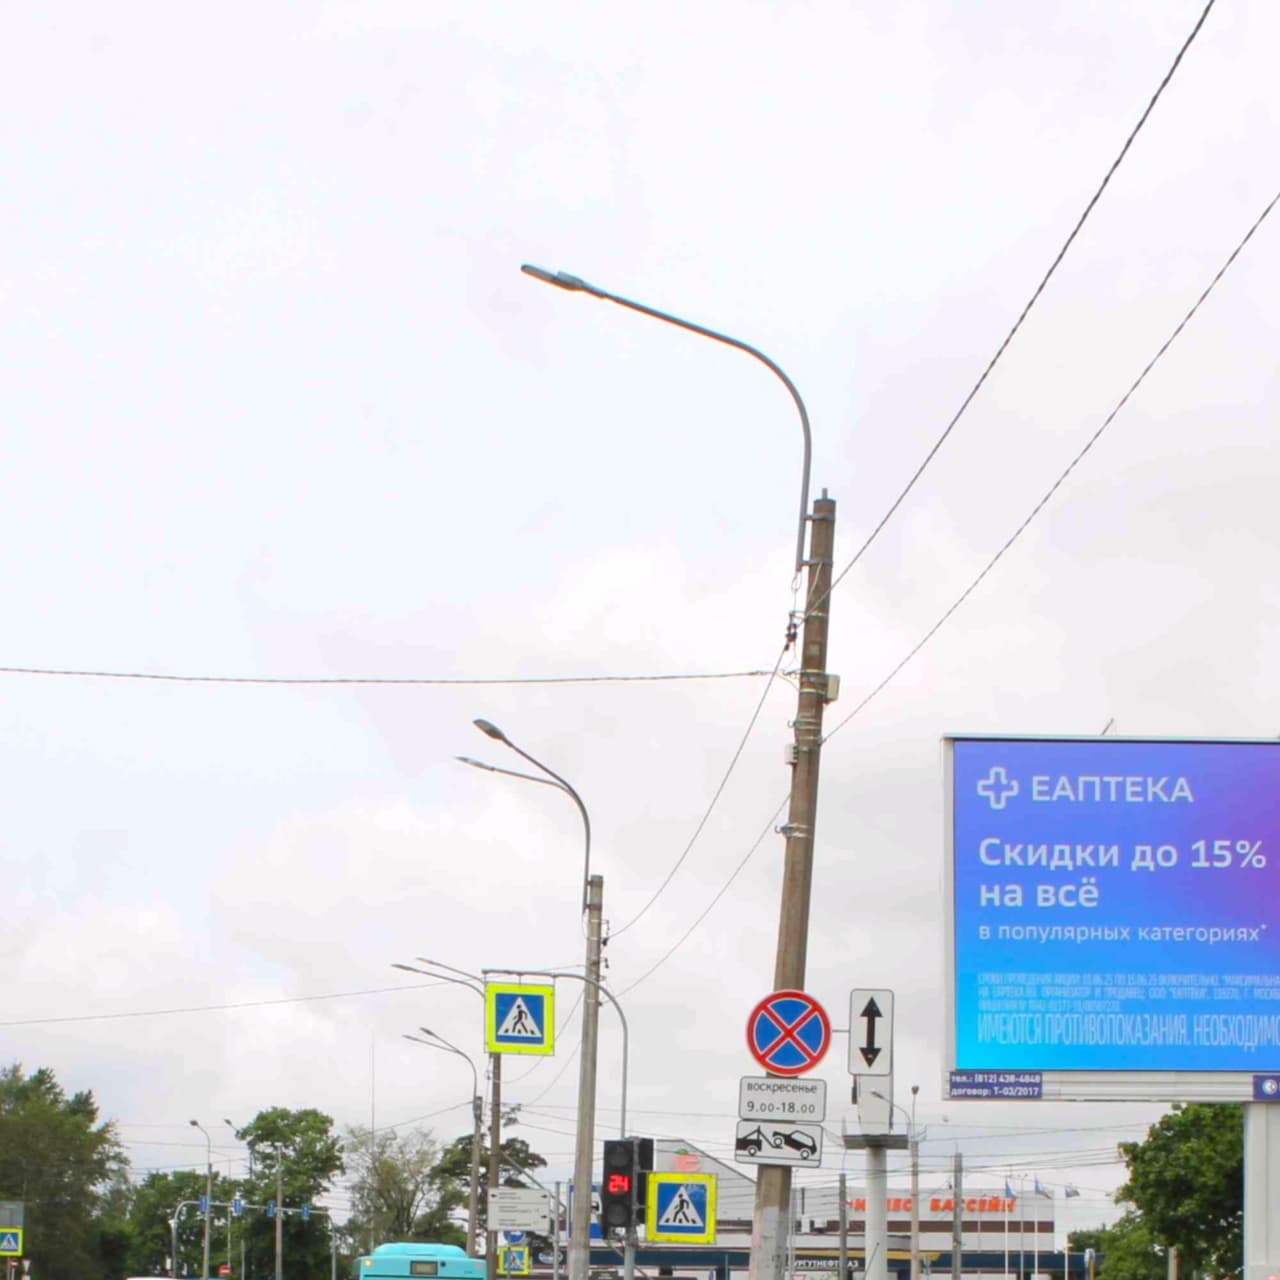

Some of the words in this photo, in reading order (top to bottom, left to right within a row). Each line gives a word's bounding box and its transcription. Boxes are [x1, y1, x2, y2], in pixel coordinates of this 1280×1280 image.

[1031, 775, 1195, 803] ЕАПТЕКА
[978, 837, 1120, 871] Скидки
[1131, 844, 1179, 871] до
[1191, 839, 1267, 869] 15%
[980, 883, 1023, 908] на
[1036, 877, 1099, 908] всё
[979, 925, 991, 940] в
[998, 925, 1131, 944] популярных
[978, 1013, 1042, 1045] ИМЕЮТСЯ
[747, 1082, 817, 1095] воскресенье
[746, 1100, 816, 1114] 9.00-18.00
